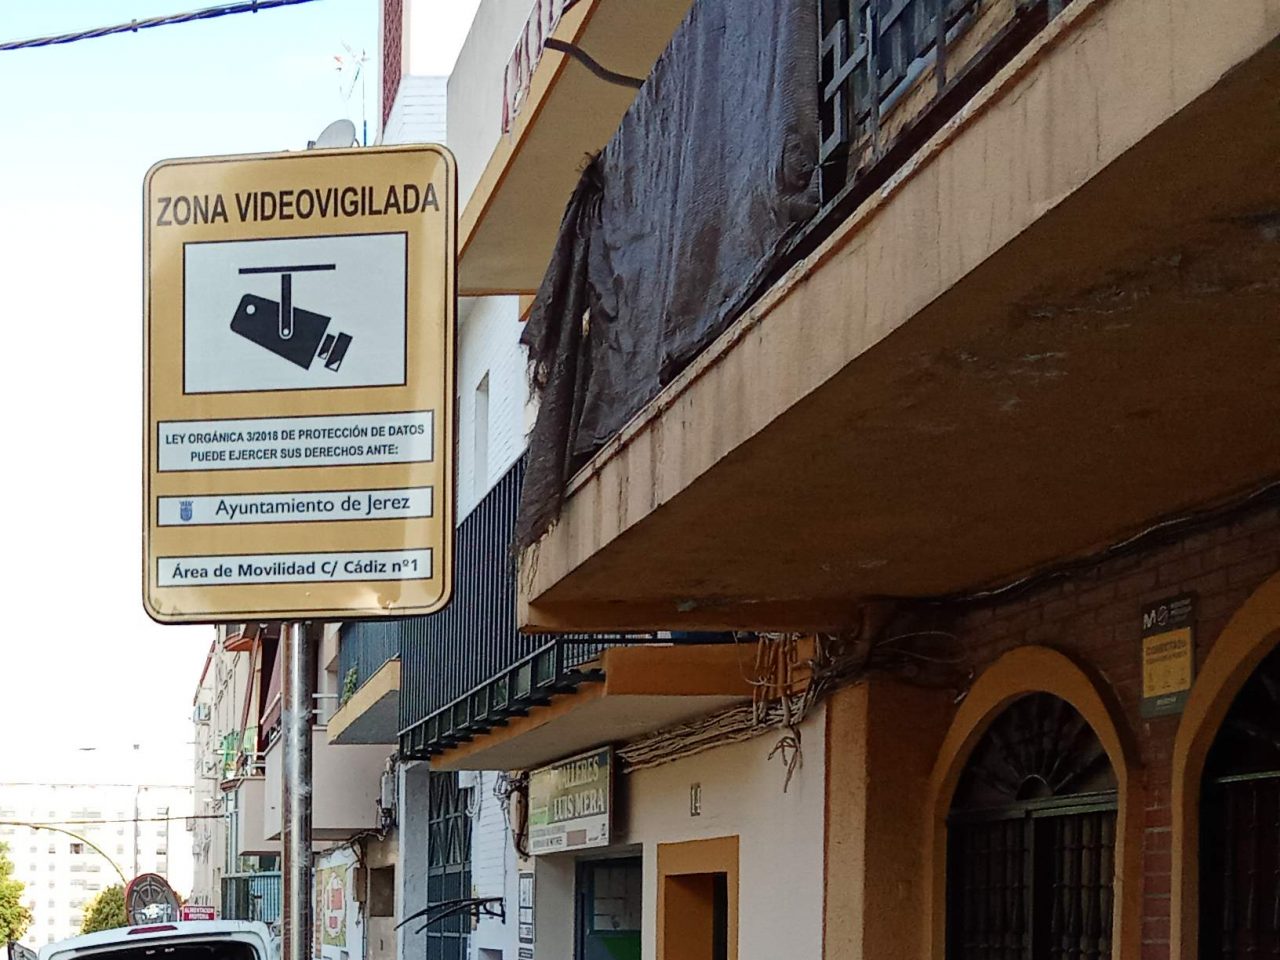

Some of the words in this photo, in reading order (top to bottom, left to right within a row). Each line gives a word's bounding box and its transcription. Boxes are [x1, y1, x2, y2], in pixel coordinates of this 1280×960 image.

[156, 193, 228, 226] ZONA
[235, 183, 440, 223] VIDEOVIGILADA
[165, 433, 186, 445] LEY
[188, 430, 244, 444] ORGÁNICA
[246, 430, 279, 442] 3/2018
[281, 430, 296, 441] DE
[298, 425, 368, 440] PROTECCIÓN
[371, 426, 386, 437] DE
[388, 424, 425, 436] DATOS
[190, 450, 226, 462] PUEDE
[228, 448, 278, 461] EJERCER
[280, 447, 302, 459] SUS
[304, 445, 364, 458] DERECHOS
[366, 444, 399, 456] ANTE:
[215, 497, 335, 520] Ayuntamiento
[340, 495, 362, 511] de
[366, 494, 411, 515] Jerez
[172, 563, 208, 579] Área
[213, 563, 232, 578] de
[237, 561, 316, 577] Movilidad
[321, 561, 338, 577] C/
[344, 559, 387, 574] Cádiz
[553, 794, 574, 820] LUIS
[574, 788, 604, 817] MERA
